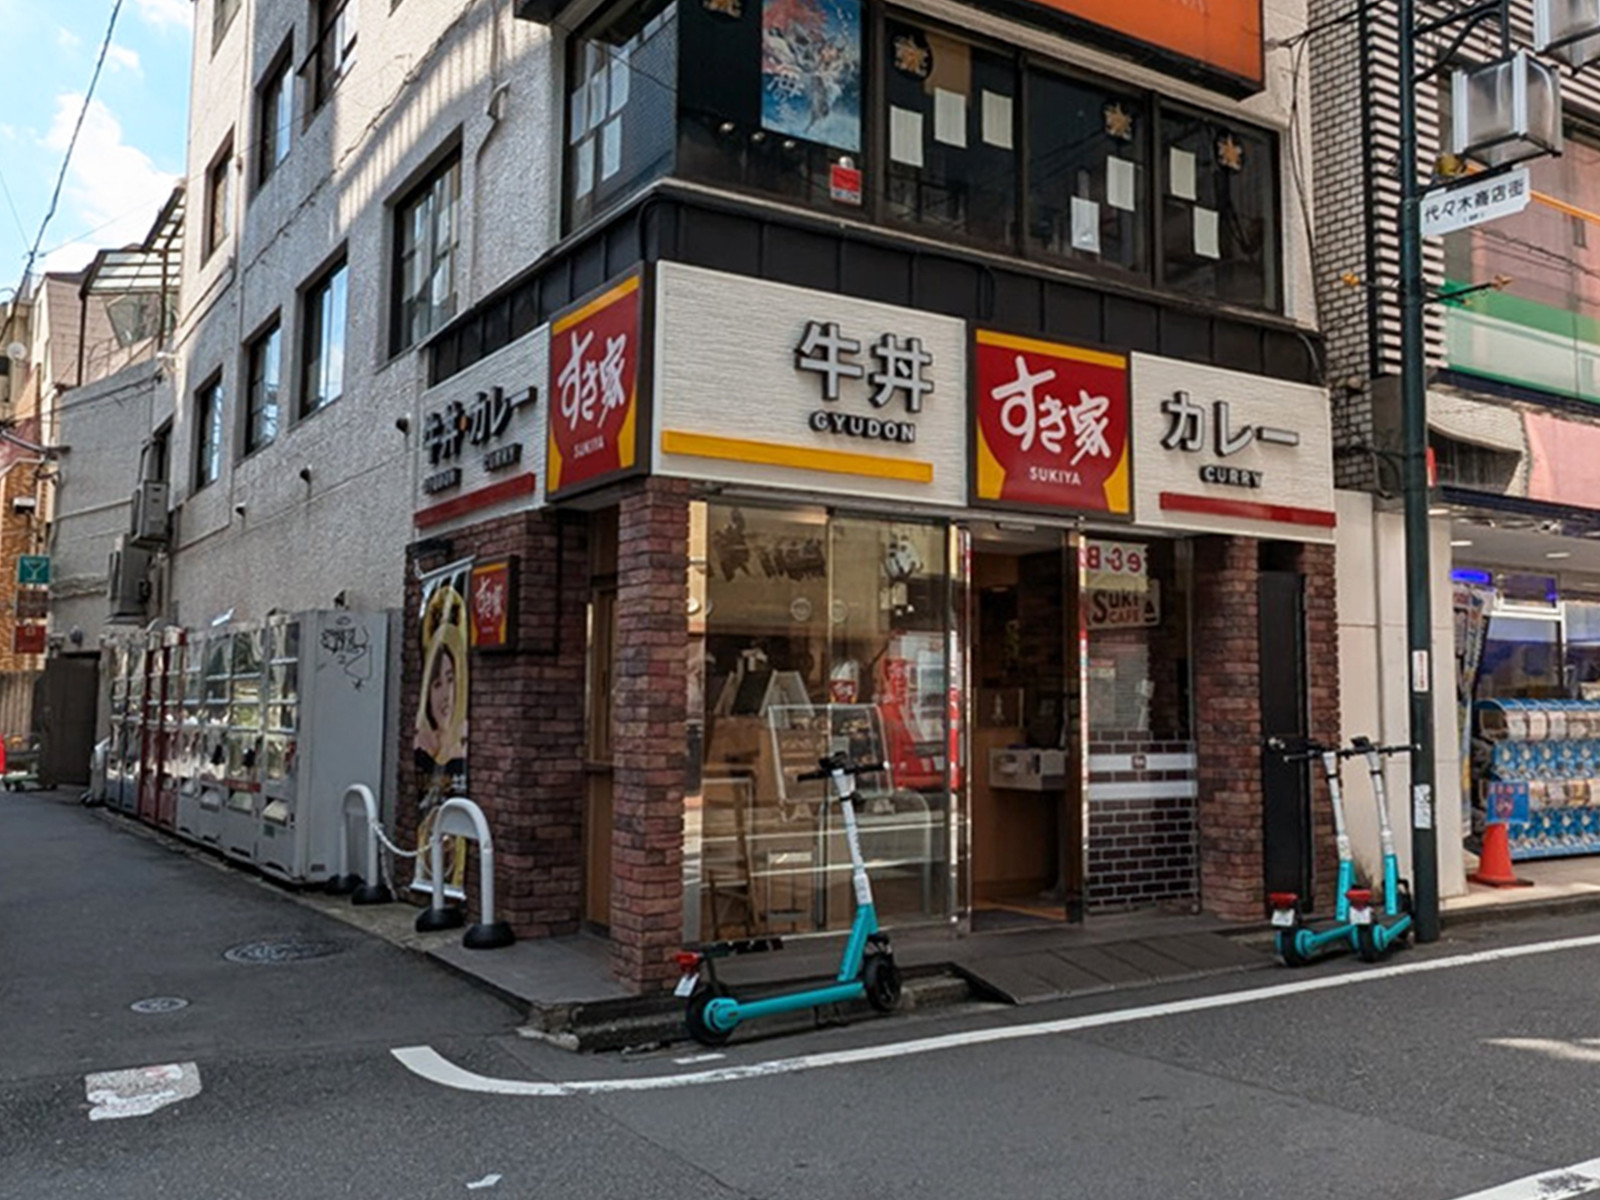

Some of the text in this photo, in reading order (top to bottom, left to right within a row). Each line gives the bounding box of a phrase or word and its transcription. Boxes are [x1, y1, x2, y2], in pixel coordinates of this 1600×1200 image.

[1424, 178, 1524, 225] 代々木商店街
[557, 330, 627, 431] すき家
[793, 319, 934, 413] 牛丼
[809, 410, 916, 443] GYUDON
[991, 355, 1111, 466] すき家
[1160, 390, 1299, 458] カレー
[1028, 466, 1081, 486] SUKIYA
[1199, 465, 1264, 488] CURRY
